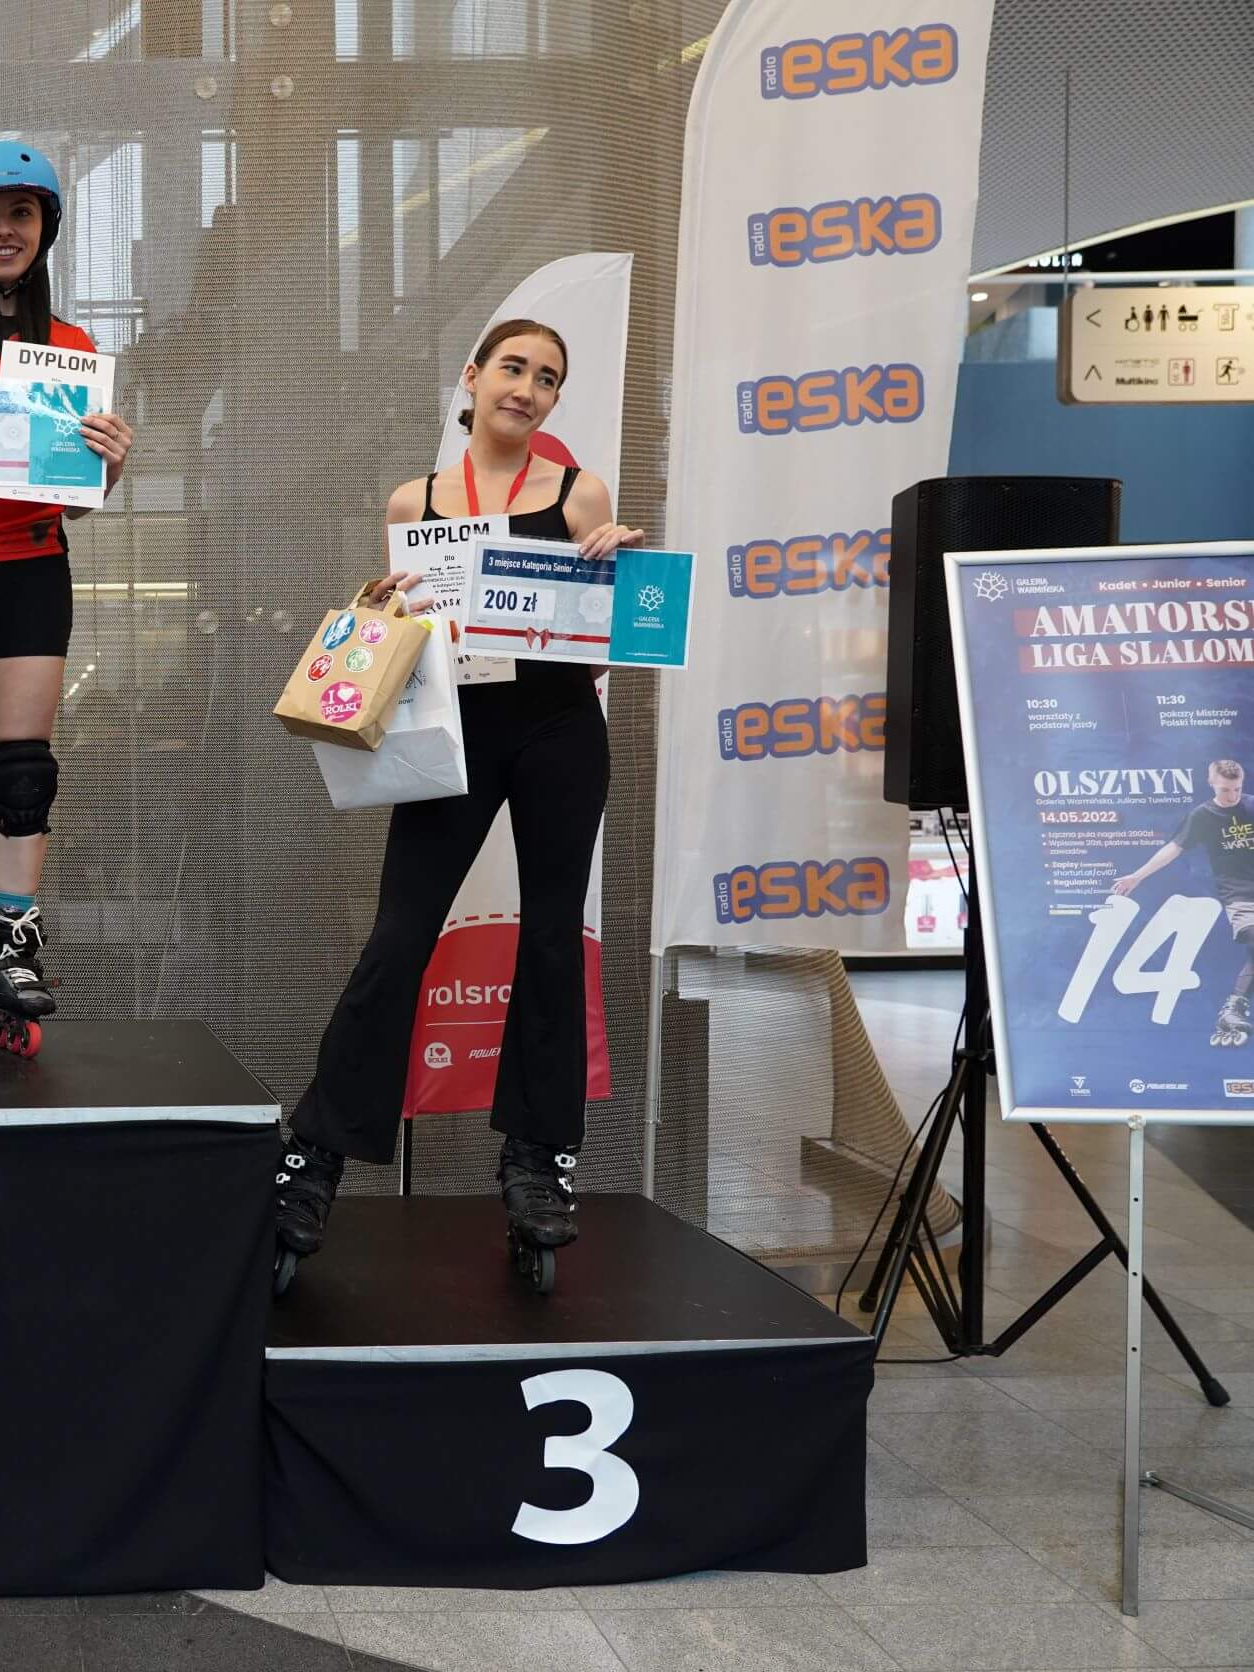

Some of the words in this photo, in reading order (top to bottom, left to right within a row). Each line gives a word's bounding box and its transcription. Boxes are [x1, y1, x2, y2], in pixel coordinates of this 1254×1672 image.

[767, 56, 776, 91] radio
[782, 28, 953, 95] eska
[754, 222, 764, 257] radio
[769, 198, 936, 262] eska
[19, 349, 97, 374] DYPLOM
[744, 390, 753, 424] radio
[757, 367, 919, 430] eska
[407, 522, 490, 547] DYPLOM
[494, 558, 521, 570] miejsce
[522, 559, 552, 571] Kategoria
[553, 562, 573, 573] Senior
[733, 554, 741, 588] radio
[1099, 581, 1137, 592] Kadet
[1152, 579, 1191, 590] Junior
[1206, 578, 1247, 589] Senior
[484, 589, 516, 611] 200
[522, 595, 538, 613] zł
[1030, 600, 1254, 638] AMATORS
[1031, 642, 1113, 669] LIGA
[325, 702, 358, 715] ROLKI
[1026, 699, 1058, 710] 10:30
[1156, 695, 1186, 705] 11:30
[723, 718, 732, 752] radio
[1034, 768, 1194, 796] OLSZTYN
[1040, 811, 1118, 823] 14.05.2022
[720, 882, 728, 915] radio
[731, 863, 886, 918] eska
[1058, 894, 1223, 1025] 14
[427, 979, 512, 1007] rolsro
[510, 1368, 640, 1545] 3
